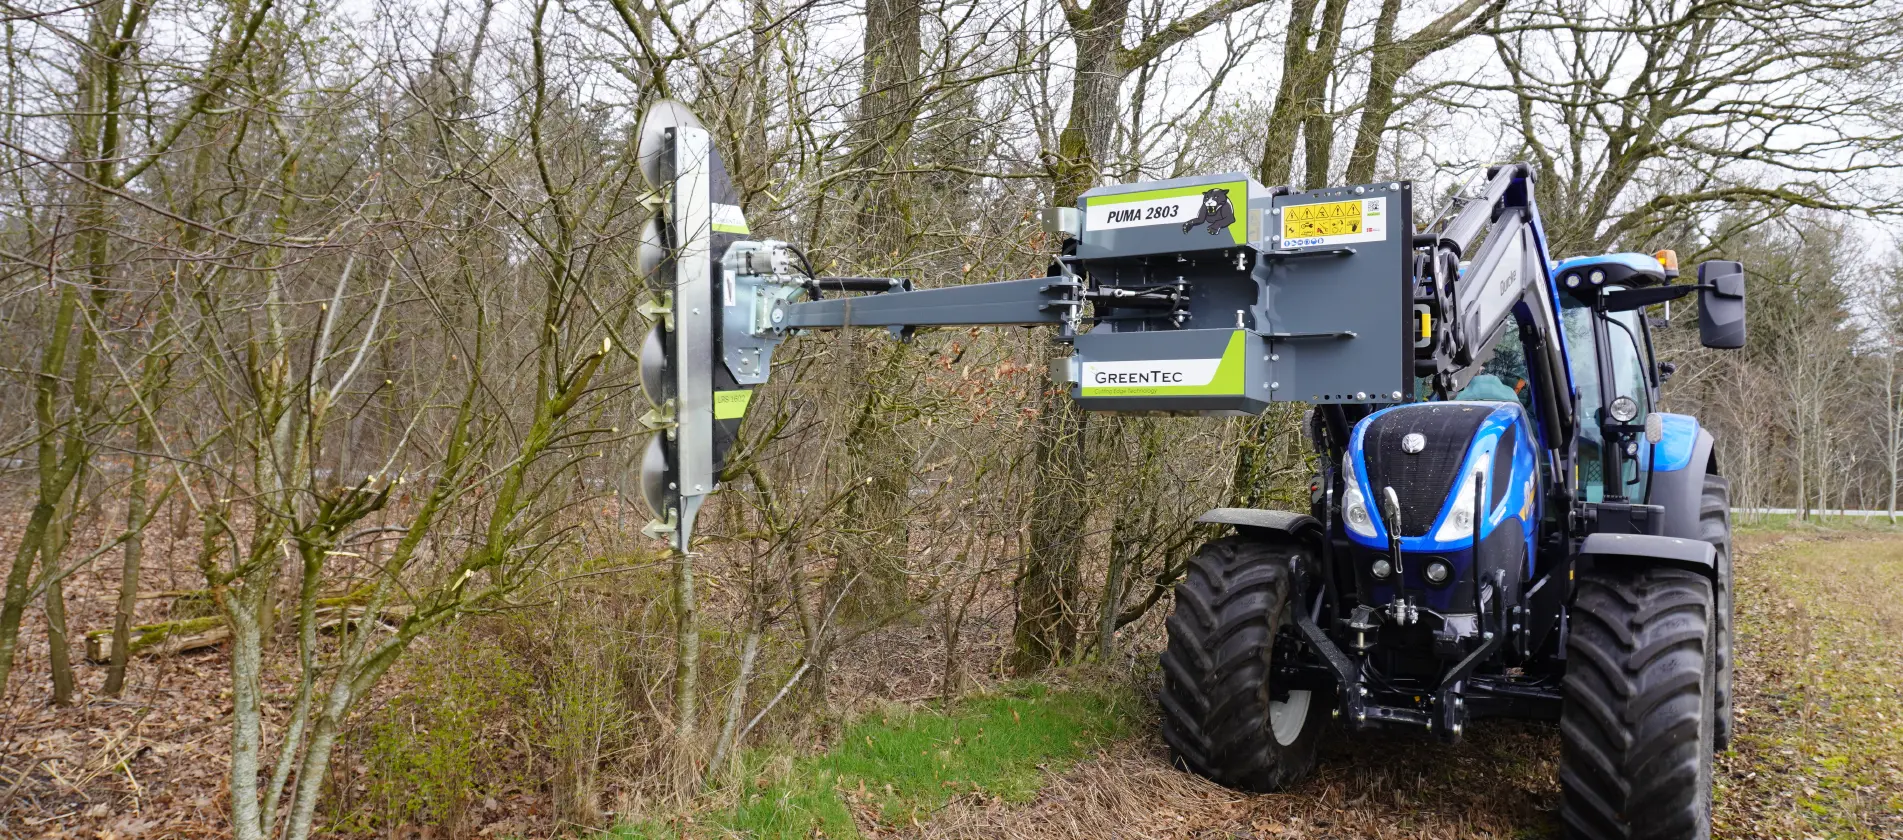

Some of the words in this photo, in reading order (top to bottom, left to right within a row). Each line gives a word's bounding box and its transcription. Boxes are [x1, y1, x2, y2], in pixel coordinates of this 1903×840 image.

[1107, 208, 1141, 224] PUMA
[1145, 204, 1179, 220] 2803
[1500, 270, 1516, 296] Quicke
